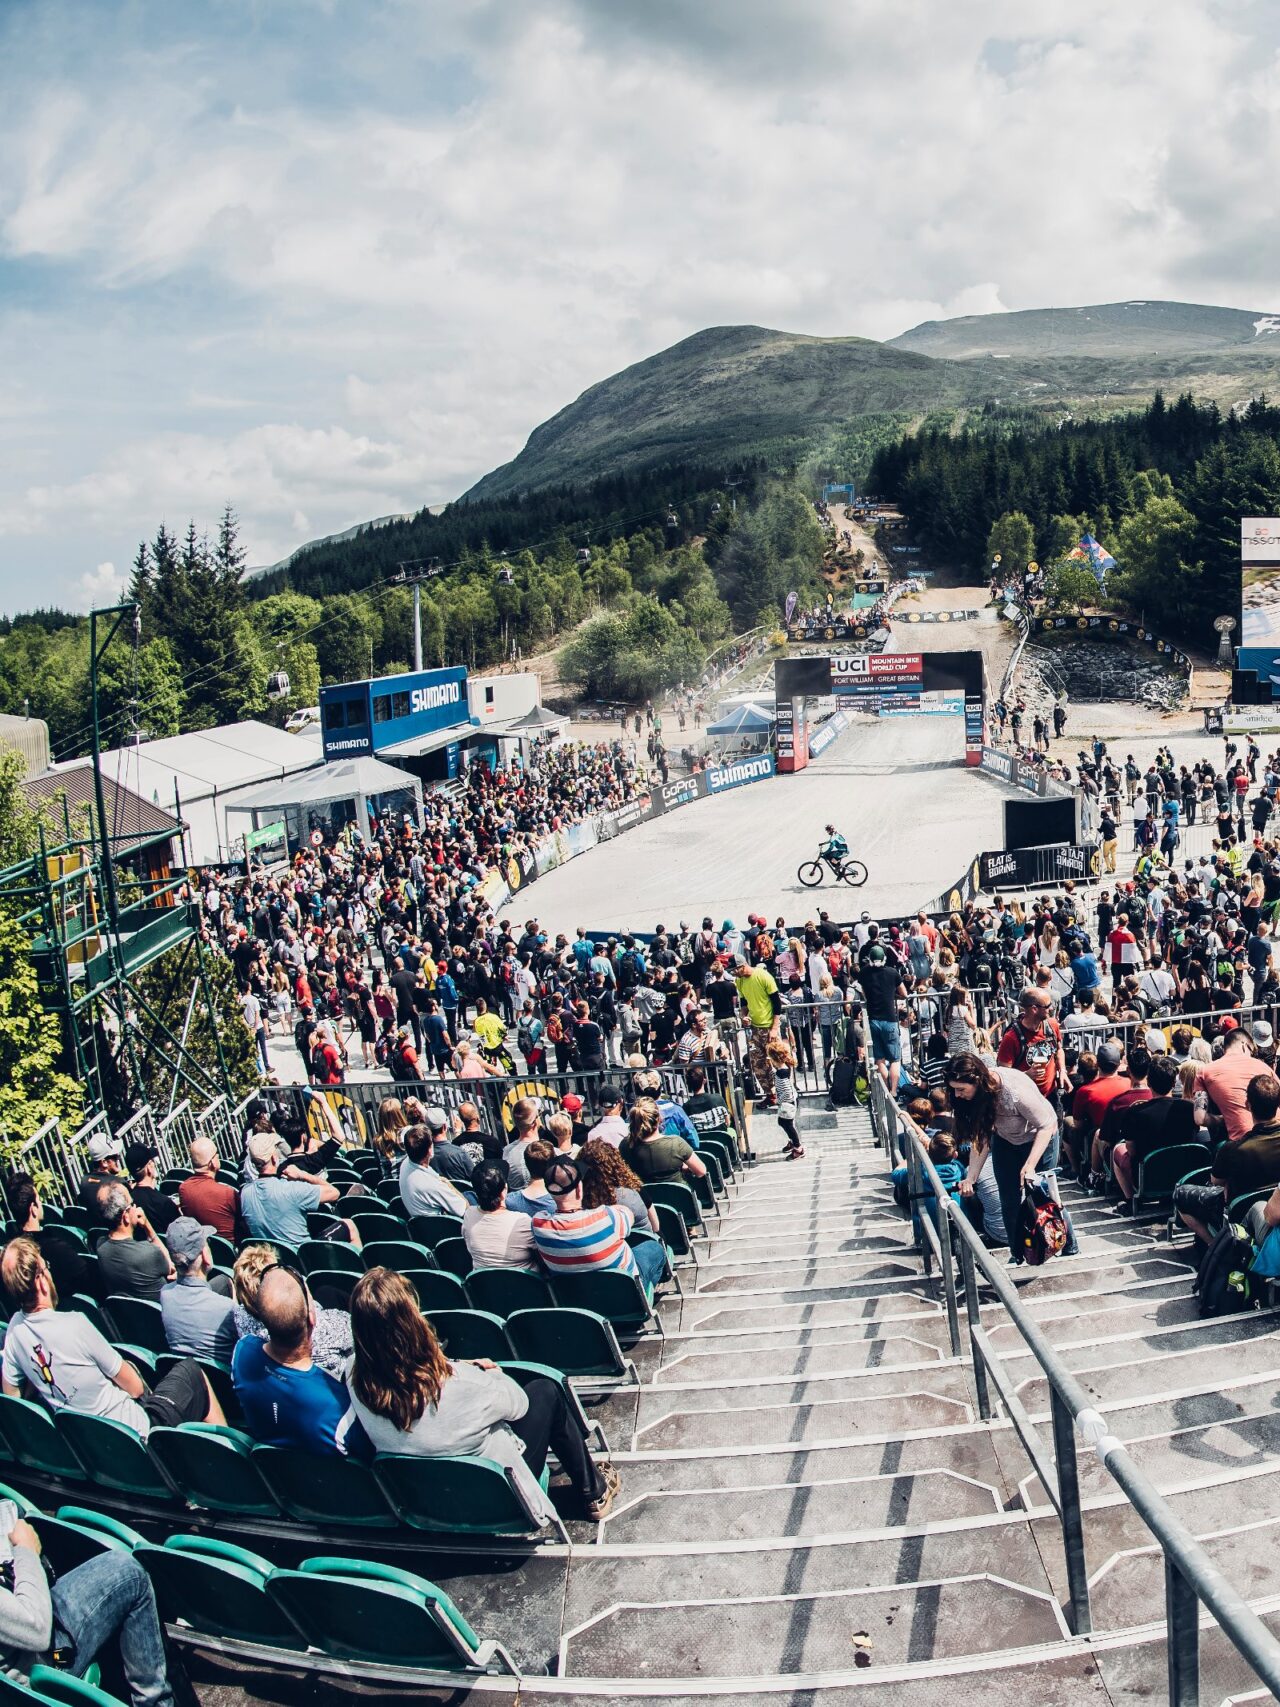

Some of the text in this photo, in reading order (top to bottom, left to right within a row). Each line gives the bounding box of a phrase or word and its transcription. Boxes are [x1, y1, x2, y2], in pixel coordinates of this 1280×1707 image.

[837, 659, 867, 672] UCI
[411, 682, 460, 713] SHIMANO
[1244, 715, 1274, 723] smidge
[326, 738, 369, 751] SHIMANO
[983, 750, 1011, 776] SHIMANO
[1017, 762, 1039, 782] GoPro
[709, 758, 771, 788] SHIMANO
[662, 778, 697, 800] GoPro
[988, 853, 1013, 869] FLAT IS
[989, 860, 1017, 878] BORING
